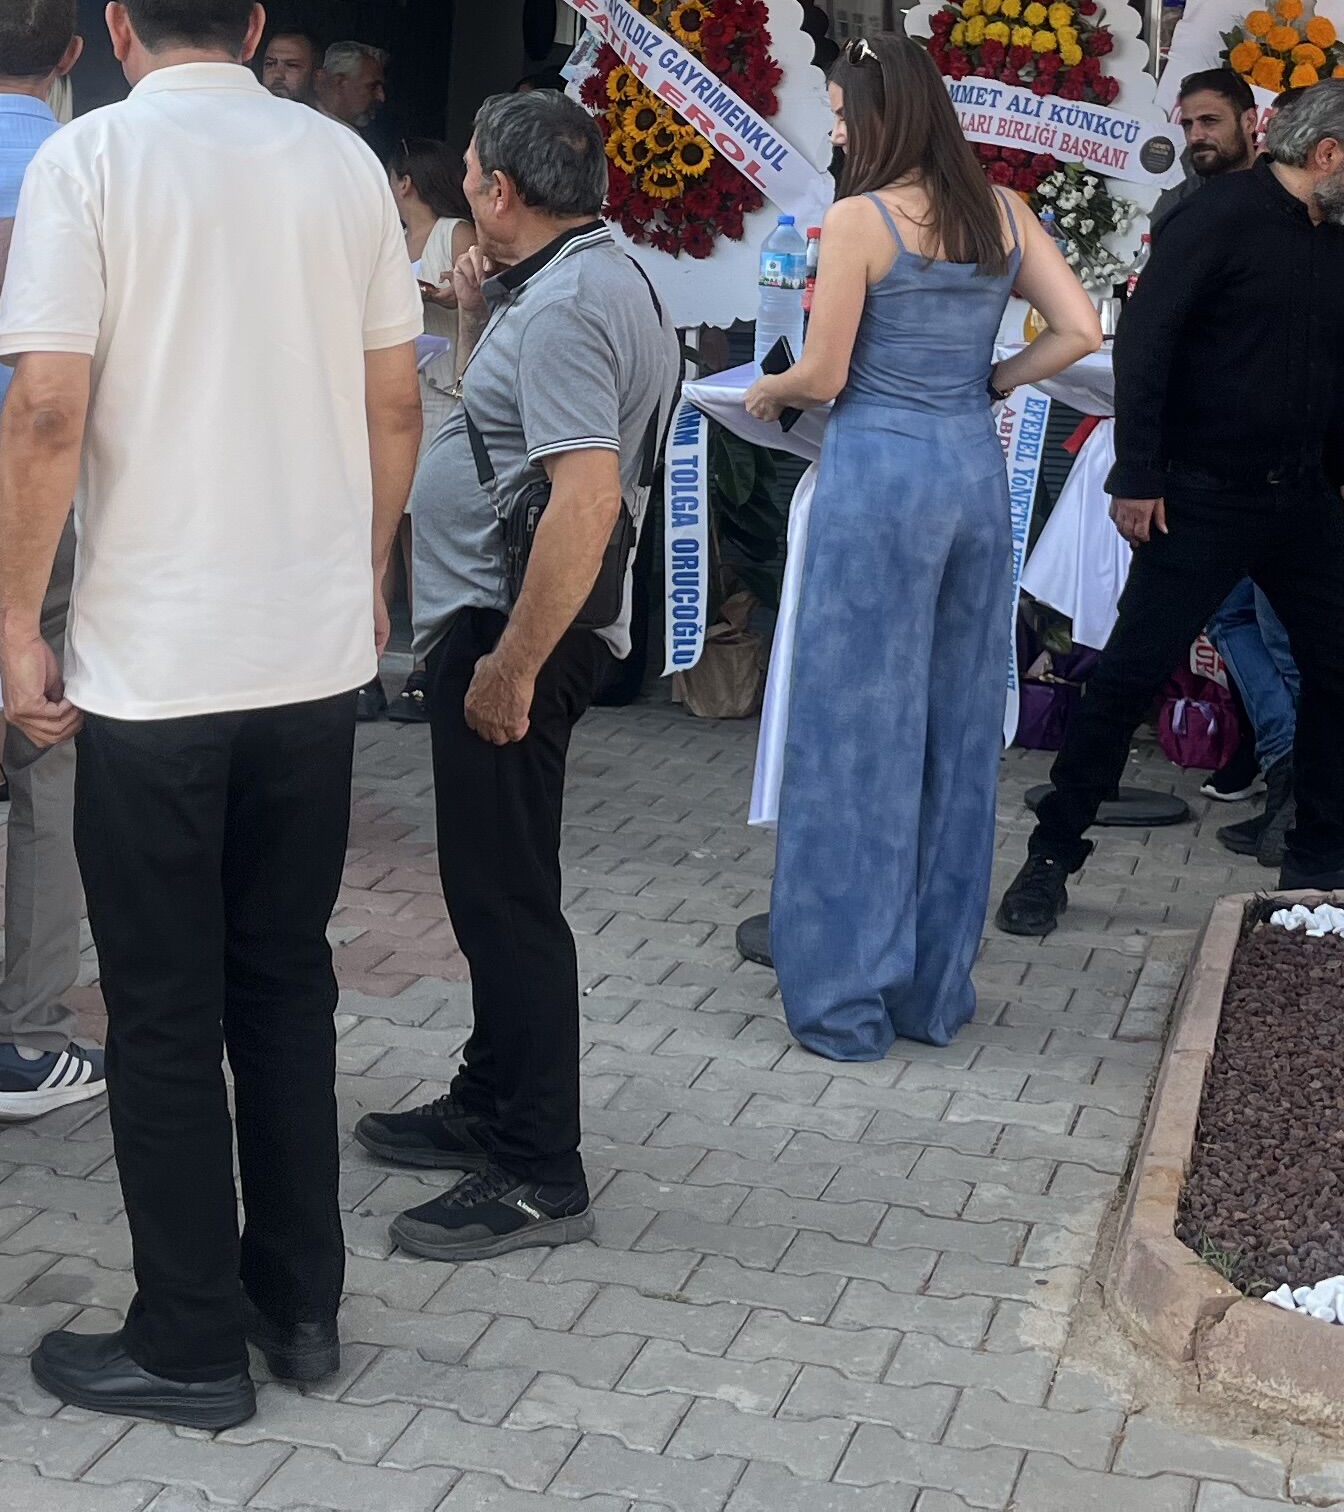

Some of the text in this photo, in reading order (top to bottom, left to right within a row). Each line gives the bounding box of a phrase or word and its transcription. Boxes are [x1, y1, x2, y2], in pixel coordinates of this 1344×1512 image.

[657, 80, 768, 189] EROL
[658, 48, 790, 173] GAYRİMENKUL
[995, 115, 1058, 146] BİRLİĞİ
[1058, 136, 1130, 170] BAŞKANI
[1006, 93, 1045, 118] ALİ
[1048, 103, 1141, 144] KÜNKCÜ
[670, 455, 699, 529] TOLGA
[667, 538, 703, 665] ORUÇOĞLU
